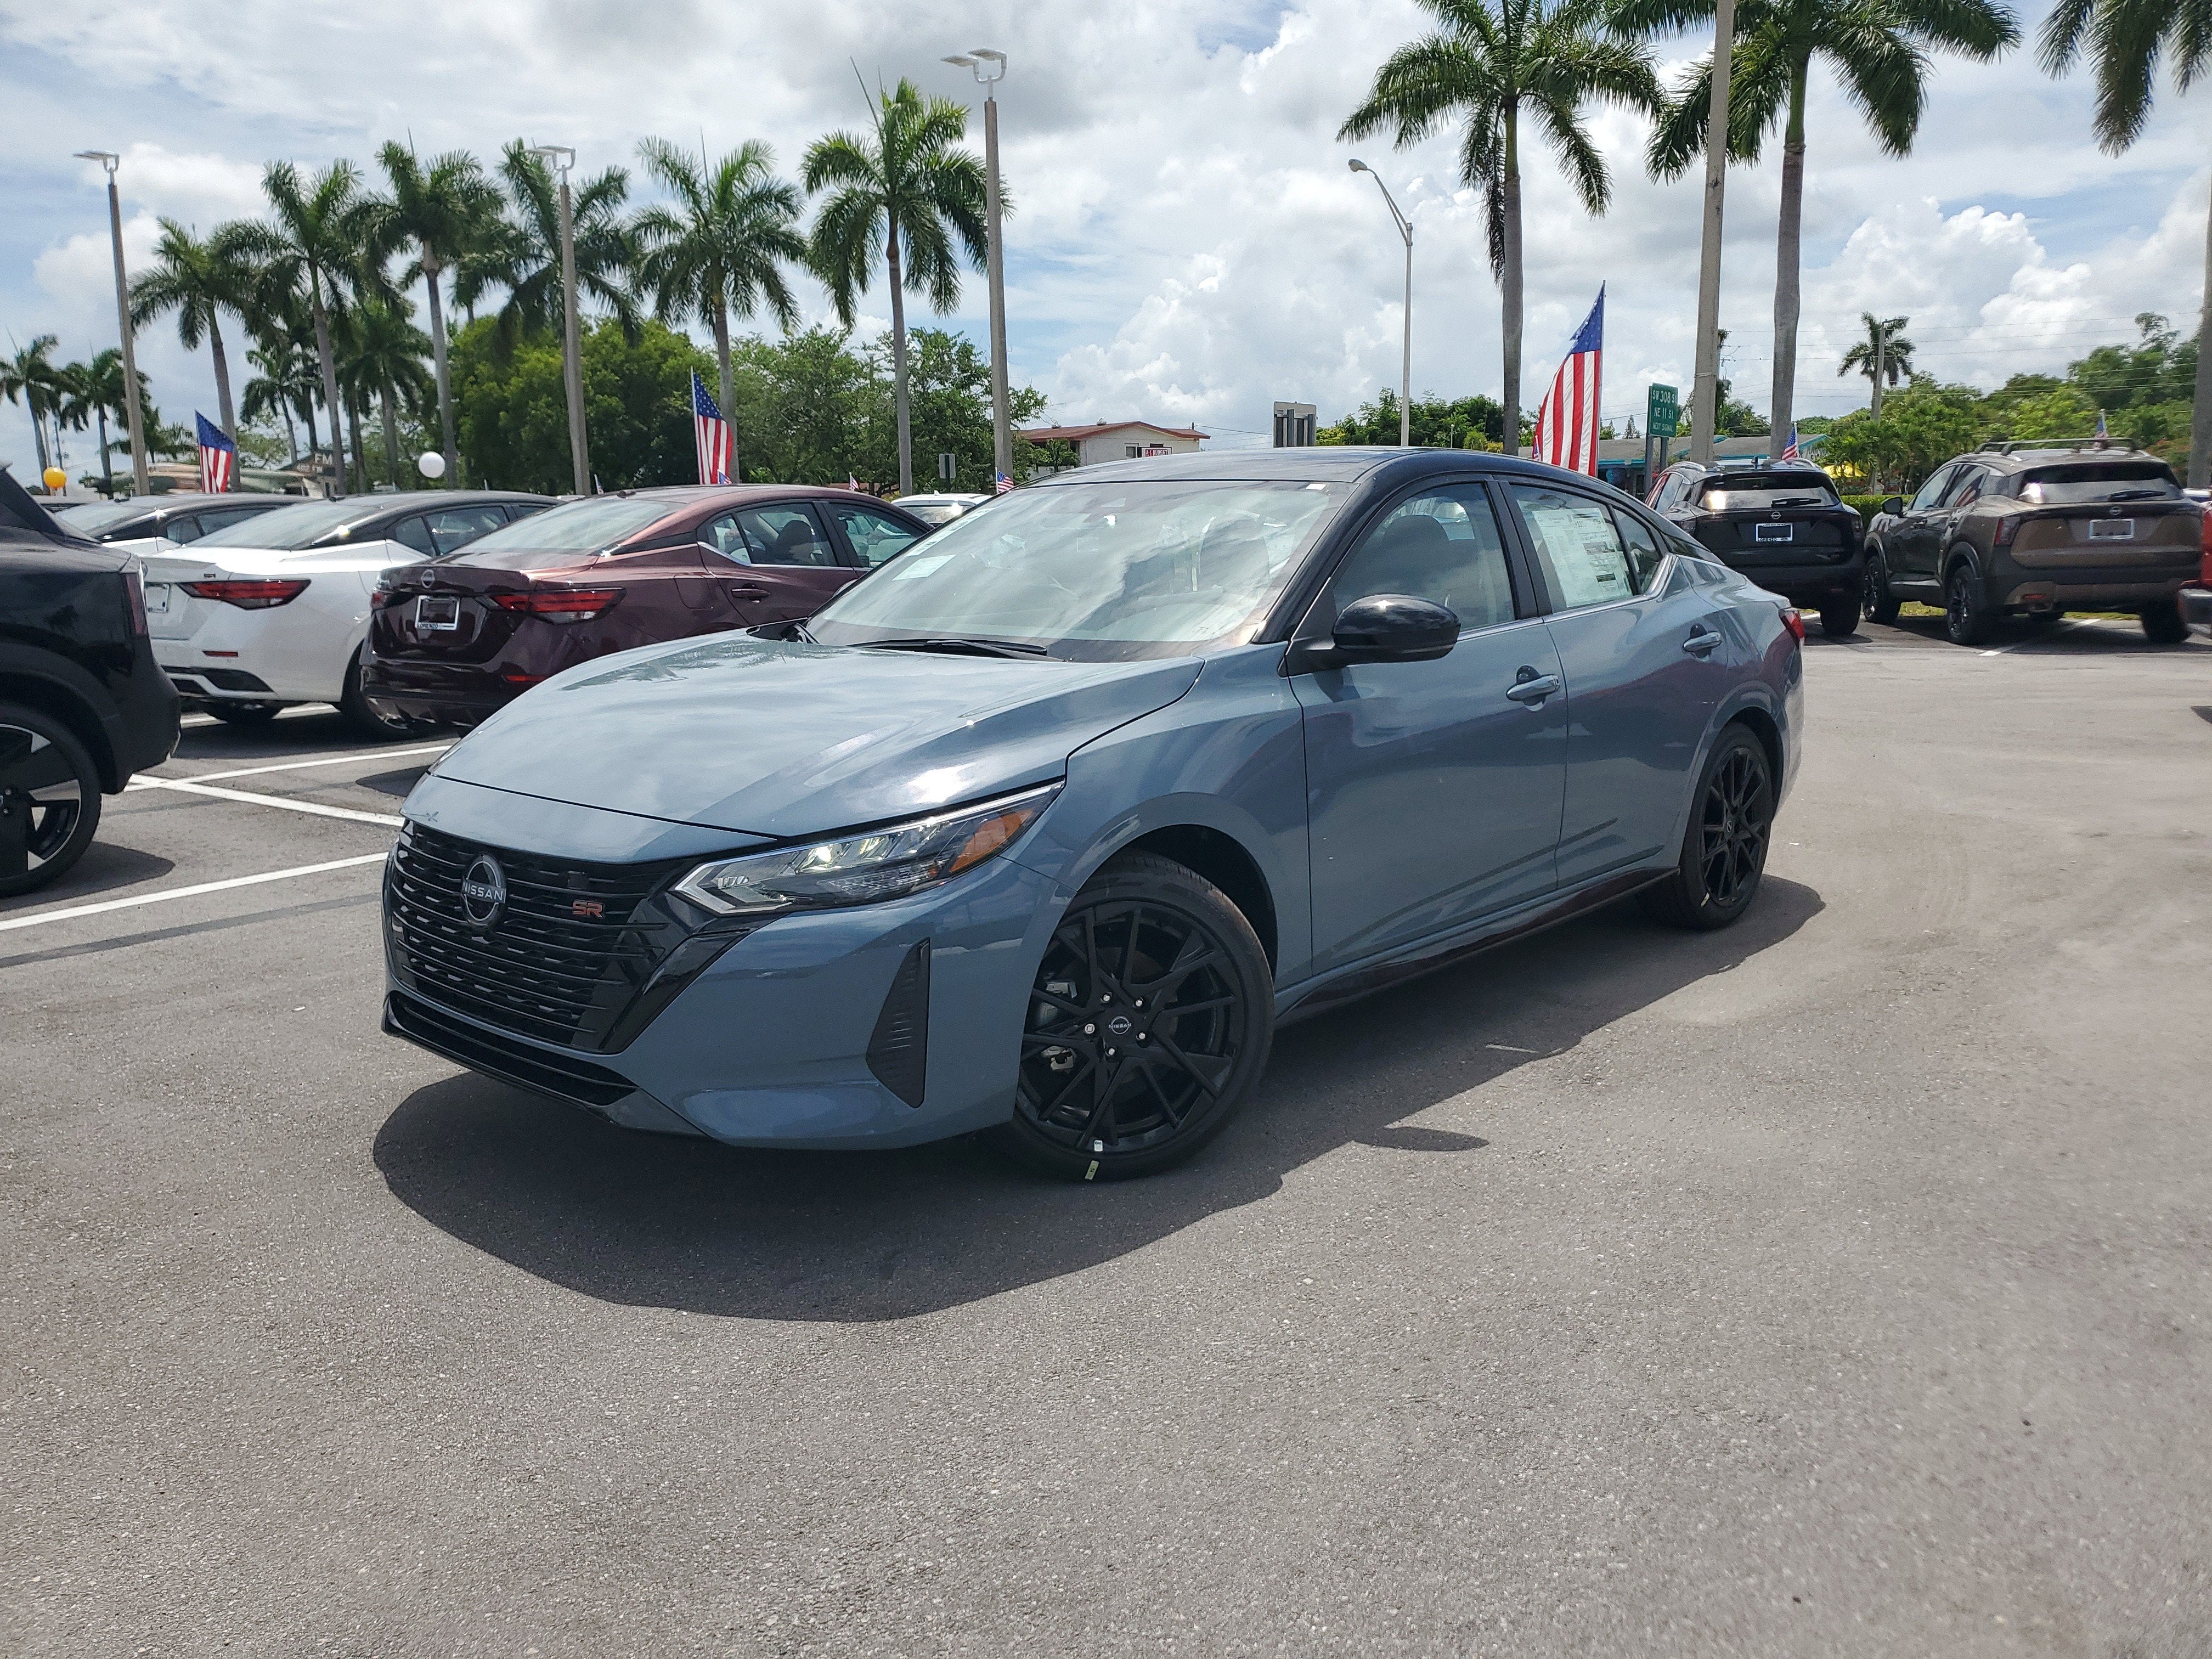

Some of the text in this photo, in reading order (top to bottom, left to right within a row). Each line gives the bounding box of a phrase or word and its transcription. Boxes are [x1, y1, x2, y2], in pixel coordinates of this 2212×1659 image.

[1652, 390, 1660, 400] SW
[1660, 390, 1671, 404] 308
[1654, 407, 1661, 417] NE
[1662, 407, 1667, 419] 11
[462, 881, 504, 901] NISSAN
[572, 901, 602, 918] SR
